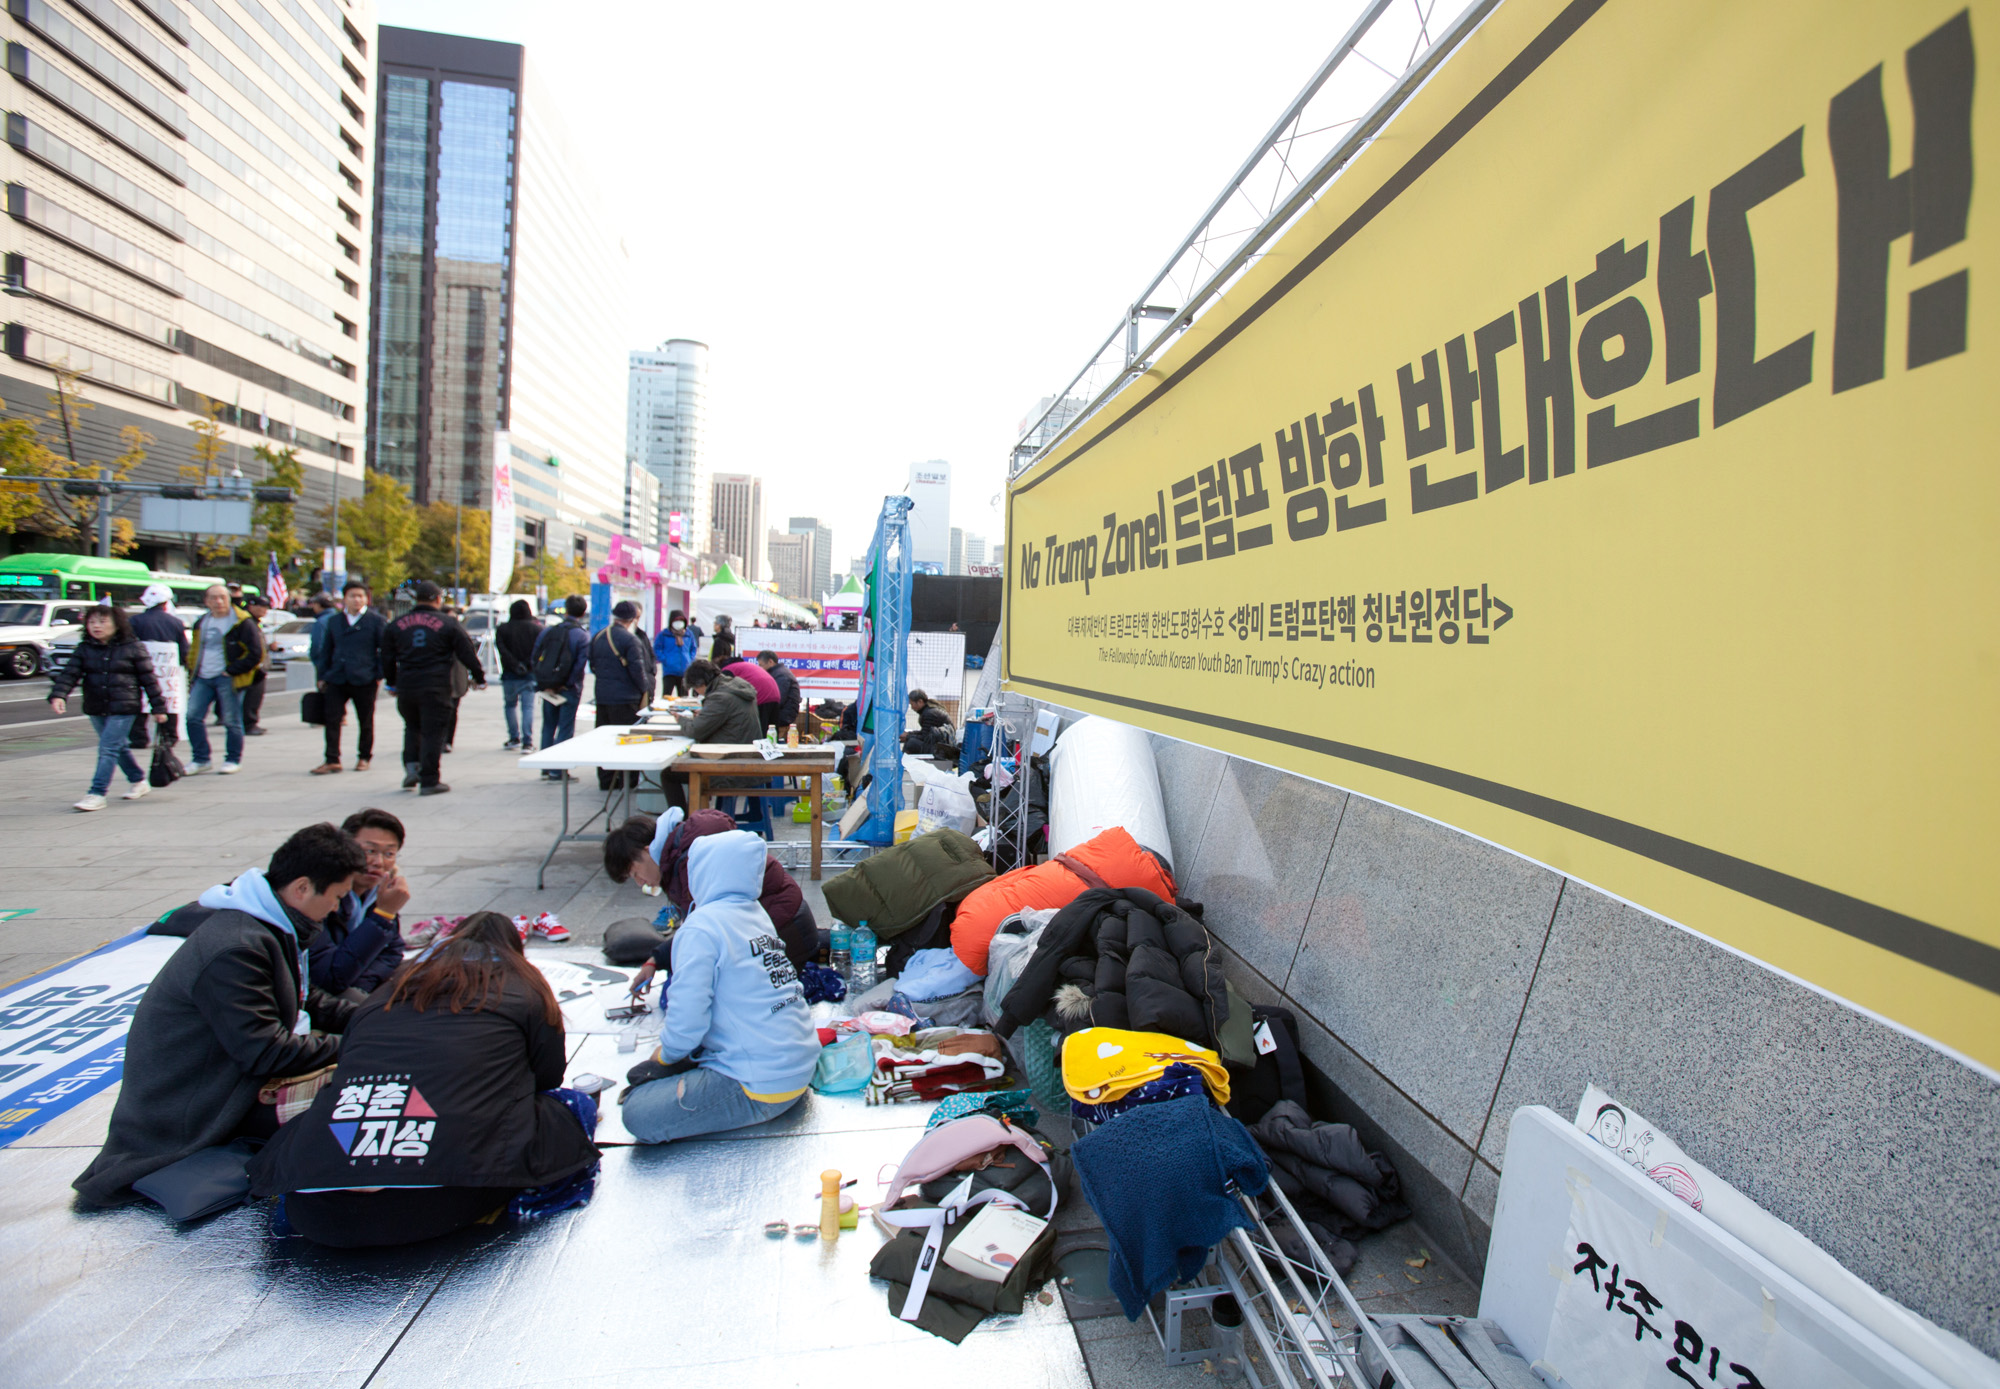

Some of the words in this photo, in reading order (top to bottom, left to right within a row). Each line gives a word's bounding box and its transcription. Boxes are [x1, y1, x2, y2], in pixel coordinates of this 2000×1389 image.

[1020, 542, 1040, 590] No
[1045, 534, 1097, 595] Trump
[1102, 489, 1168, 577] Zone!
[1171, 442, 1273, 566] 트럼프
[1275, 382, 1387, 542] 방한
[1396, 6, 1976, 514] 반대한다!
[1067, 614, 1107, 638] 대북제재반대
[1108, 611, 1149, 639] 트럼프탄핵
[1151, 607, 1224, 640] 한반도평화수호
[1228, 602, 1264, 641] <방미
[1268, 594, 1356, 642] 트럼프탄핵
[1362, 583, 1513, 645] 청년원정단>
[1098, 647, 1108, 662] The
[1109, 648, 1139, 669] Fellowship
[1139, 648, 1147, 665] of
[1147, 649, 1168, 668] South
[1169, 651, 1196, 670] Korean
[1197, 652, 1222, 673] Youth
[1224, 653, 1242, 675] Ban
[1246, 655, 1289, 684] Trump's
[1291, 656, 1327, 690] Crazy
[1329, 658, 1375, 689] action
[332, 1082, 409, 1119] 청춘
[351, 1120, 436, 1156] 지성
